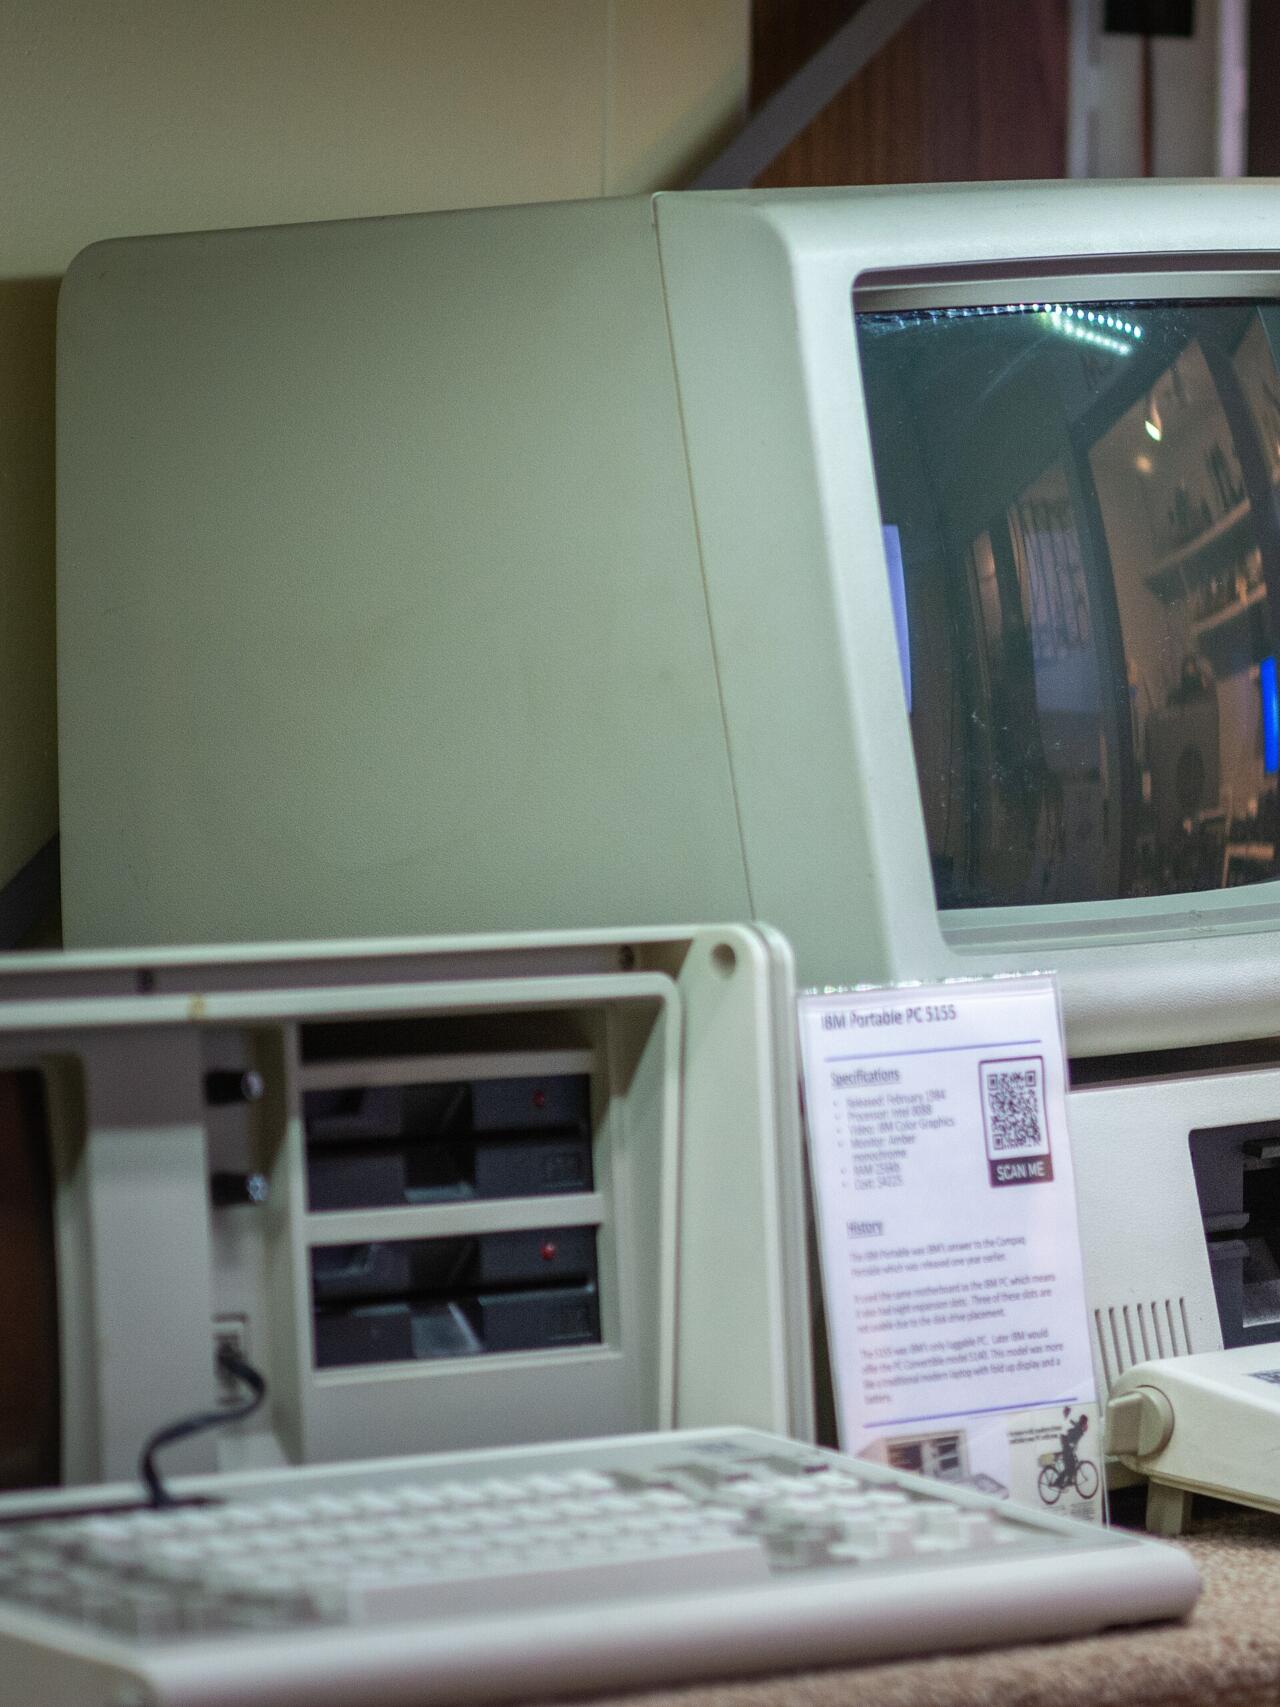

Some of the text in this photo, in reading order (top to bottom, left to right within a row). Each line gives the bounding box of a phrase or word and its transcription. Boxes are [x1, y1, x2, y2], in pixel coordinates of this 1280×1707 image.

[821, 1003, 957, 1031] IBM Portable PC 5155
[830, 1067, 900, 1088] Specifications
[894, 1119, 917, 1131] Color
[918, 1114, 955, 1130] Graphics
[996, 1161, 1045, 1180] SCAN ME
[847, 1220, 882, 1236] History
[982, 1236, 994, 1247] the
